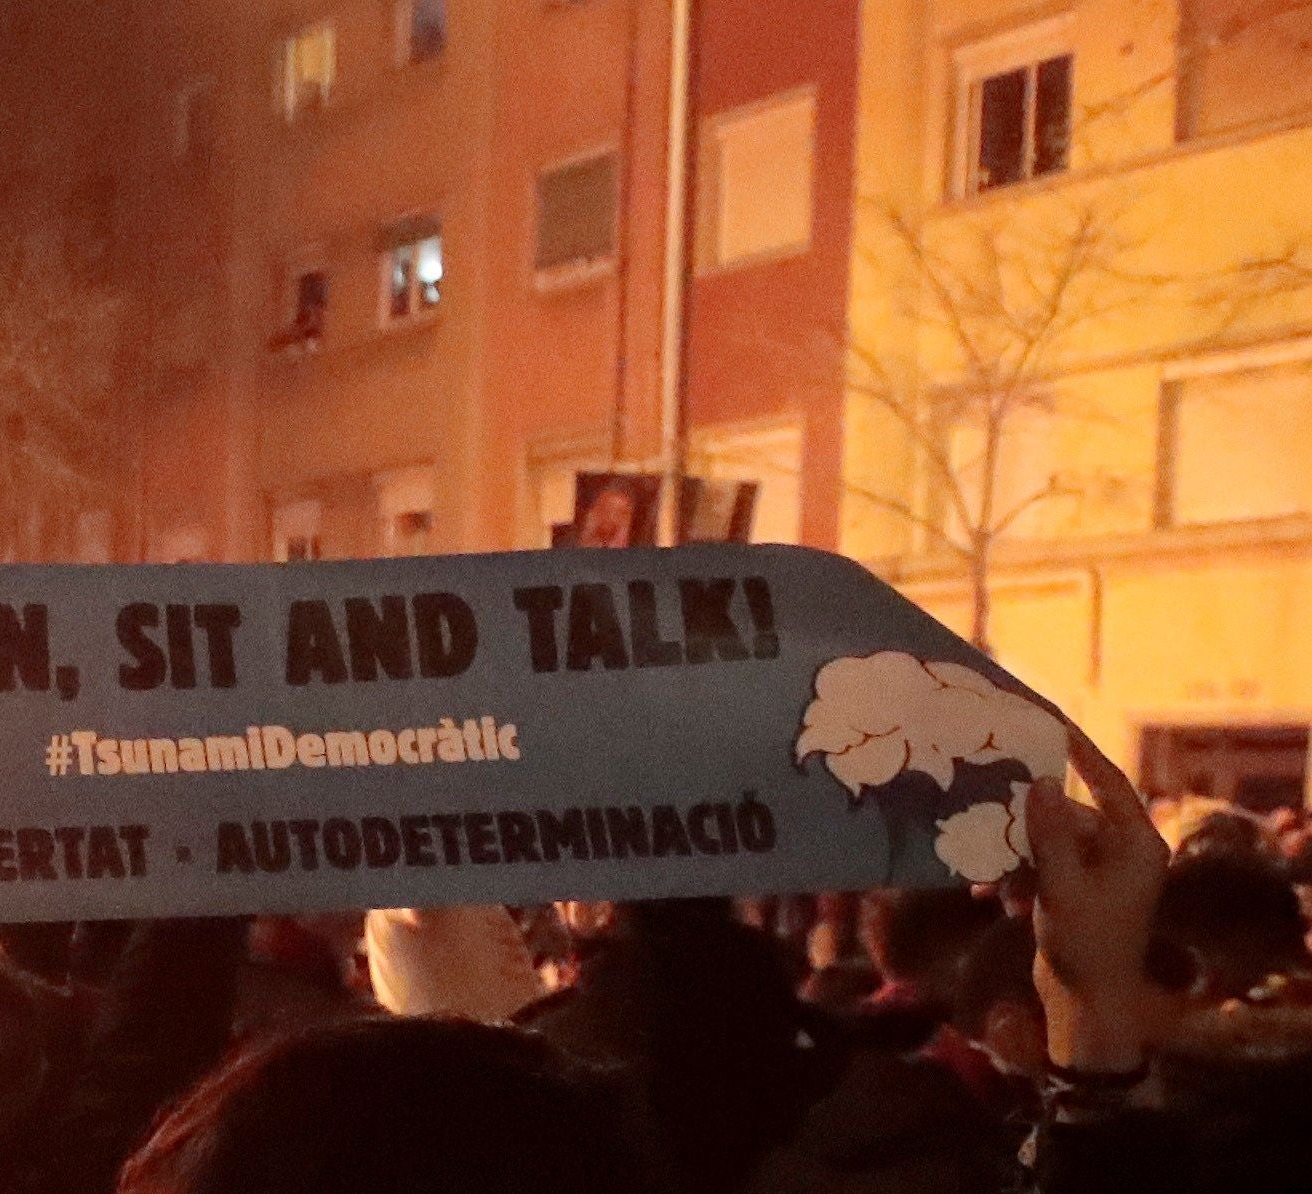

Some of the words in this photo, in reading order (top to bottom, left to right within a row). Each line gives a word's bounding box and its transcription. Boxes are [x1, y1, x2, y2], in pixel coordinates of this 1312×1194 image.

[115, 602, 243, 691] SIT
[283, 590, 478, 687] AND
[513, 576, 781, 674] TALK!
[45, 715, 521, 777] #TsunamiDemocràtic
[215, 789, 776, 875] AUTODETERMINACIÓ
